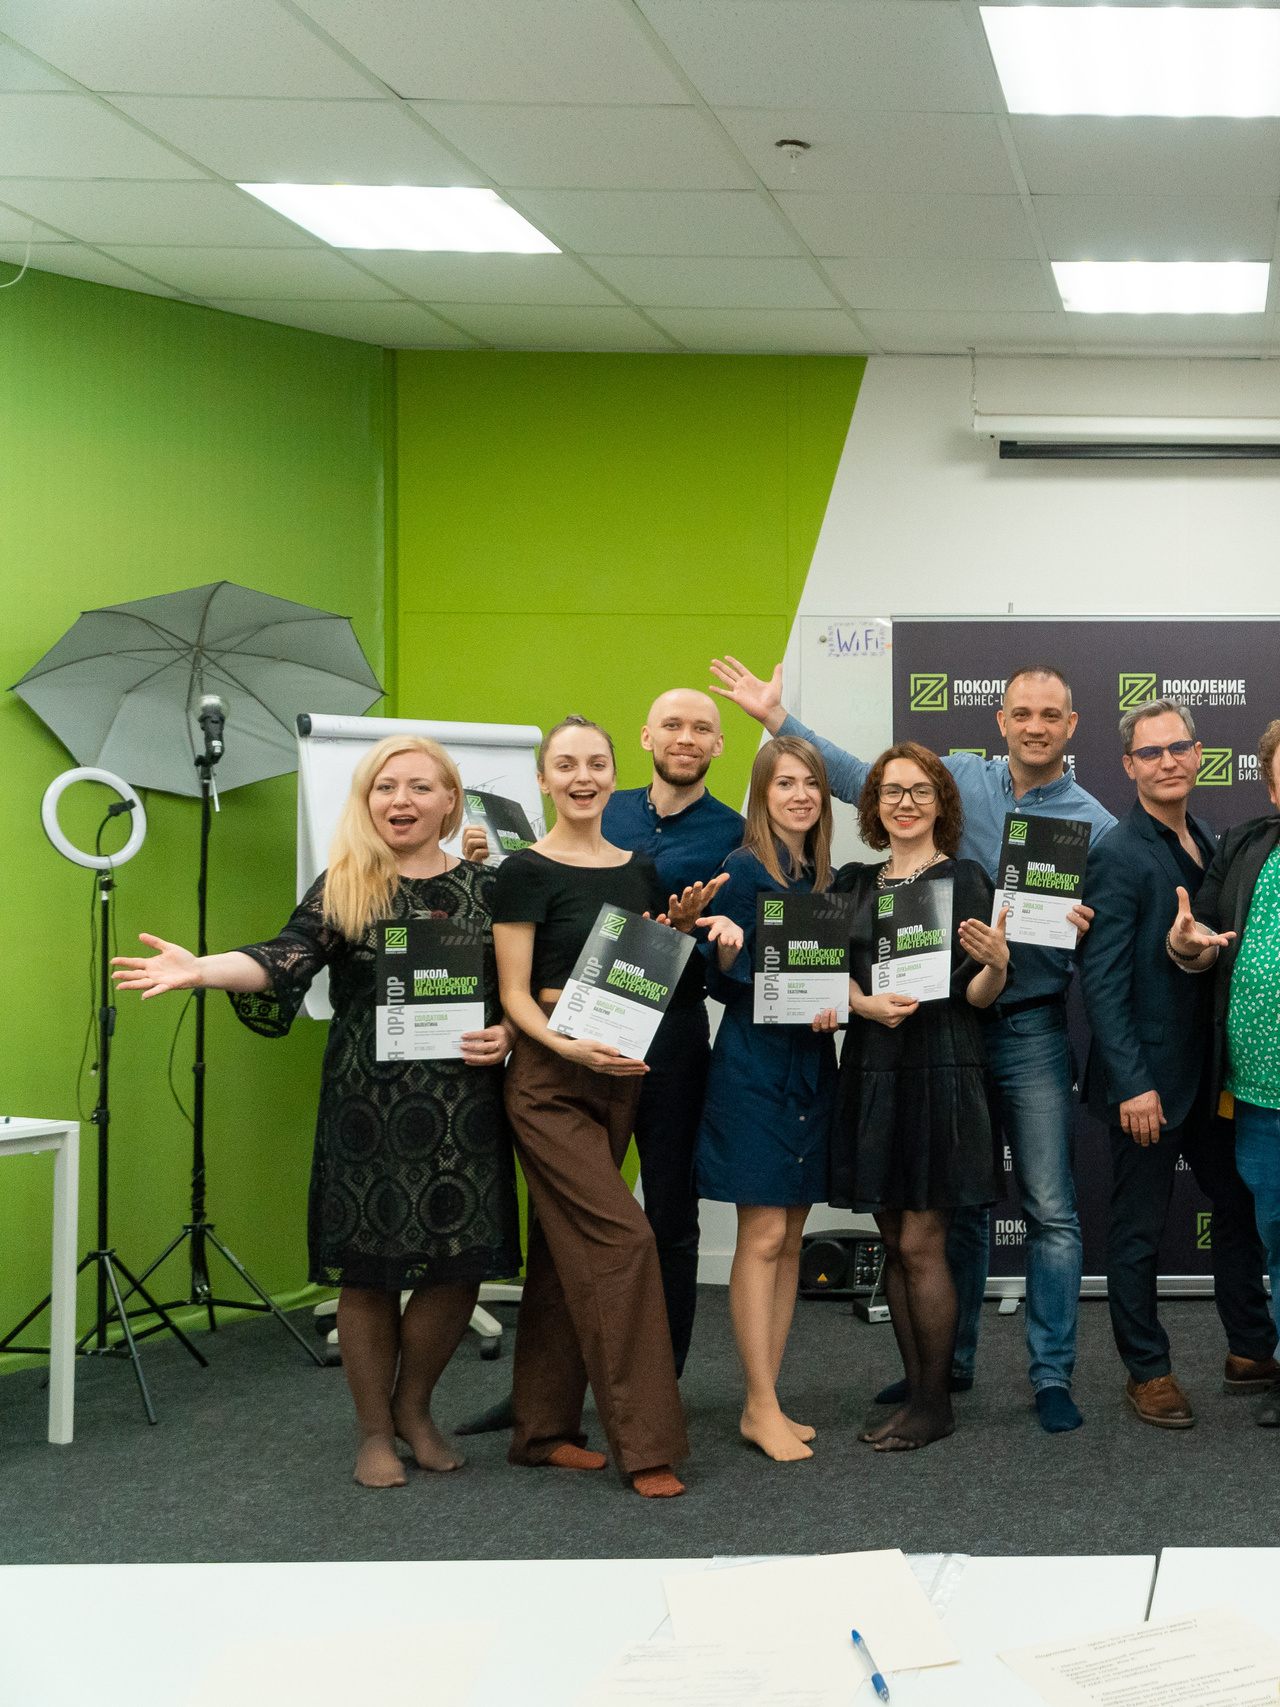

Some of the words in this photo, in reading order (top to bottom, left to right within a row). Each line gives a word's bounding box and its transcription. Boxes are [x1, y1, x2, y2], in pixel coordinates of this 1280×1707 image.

[954, 679, 1007, 694] ПОКОЛЕ
[1162, 679, 1246, 694] ПОКОЛЕНИЕ
[954, 694, 1004, 706] БИЗНЕС-
[1027, 861, 1056, 873] ШКОЛА
[897, 924, 923, 937] ШКОЛА
[788, 940, 819, 950] ШКОЛА
[413, 969, 449, 980] ШКОЛА
[612, 959, 646, 978] ШКОЛА
